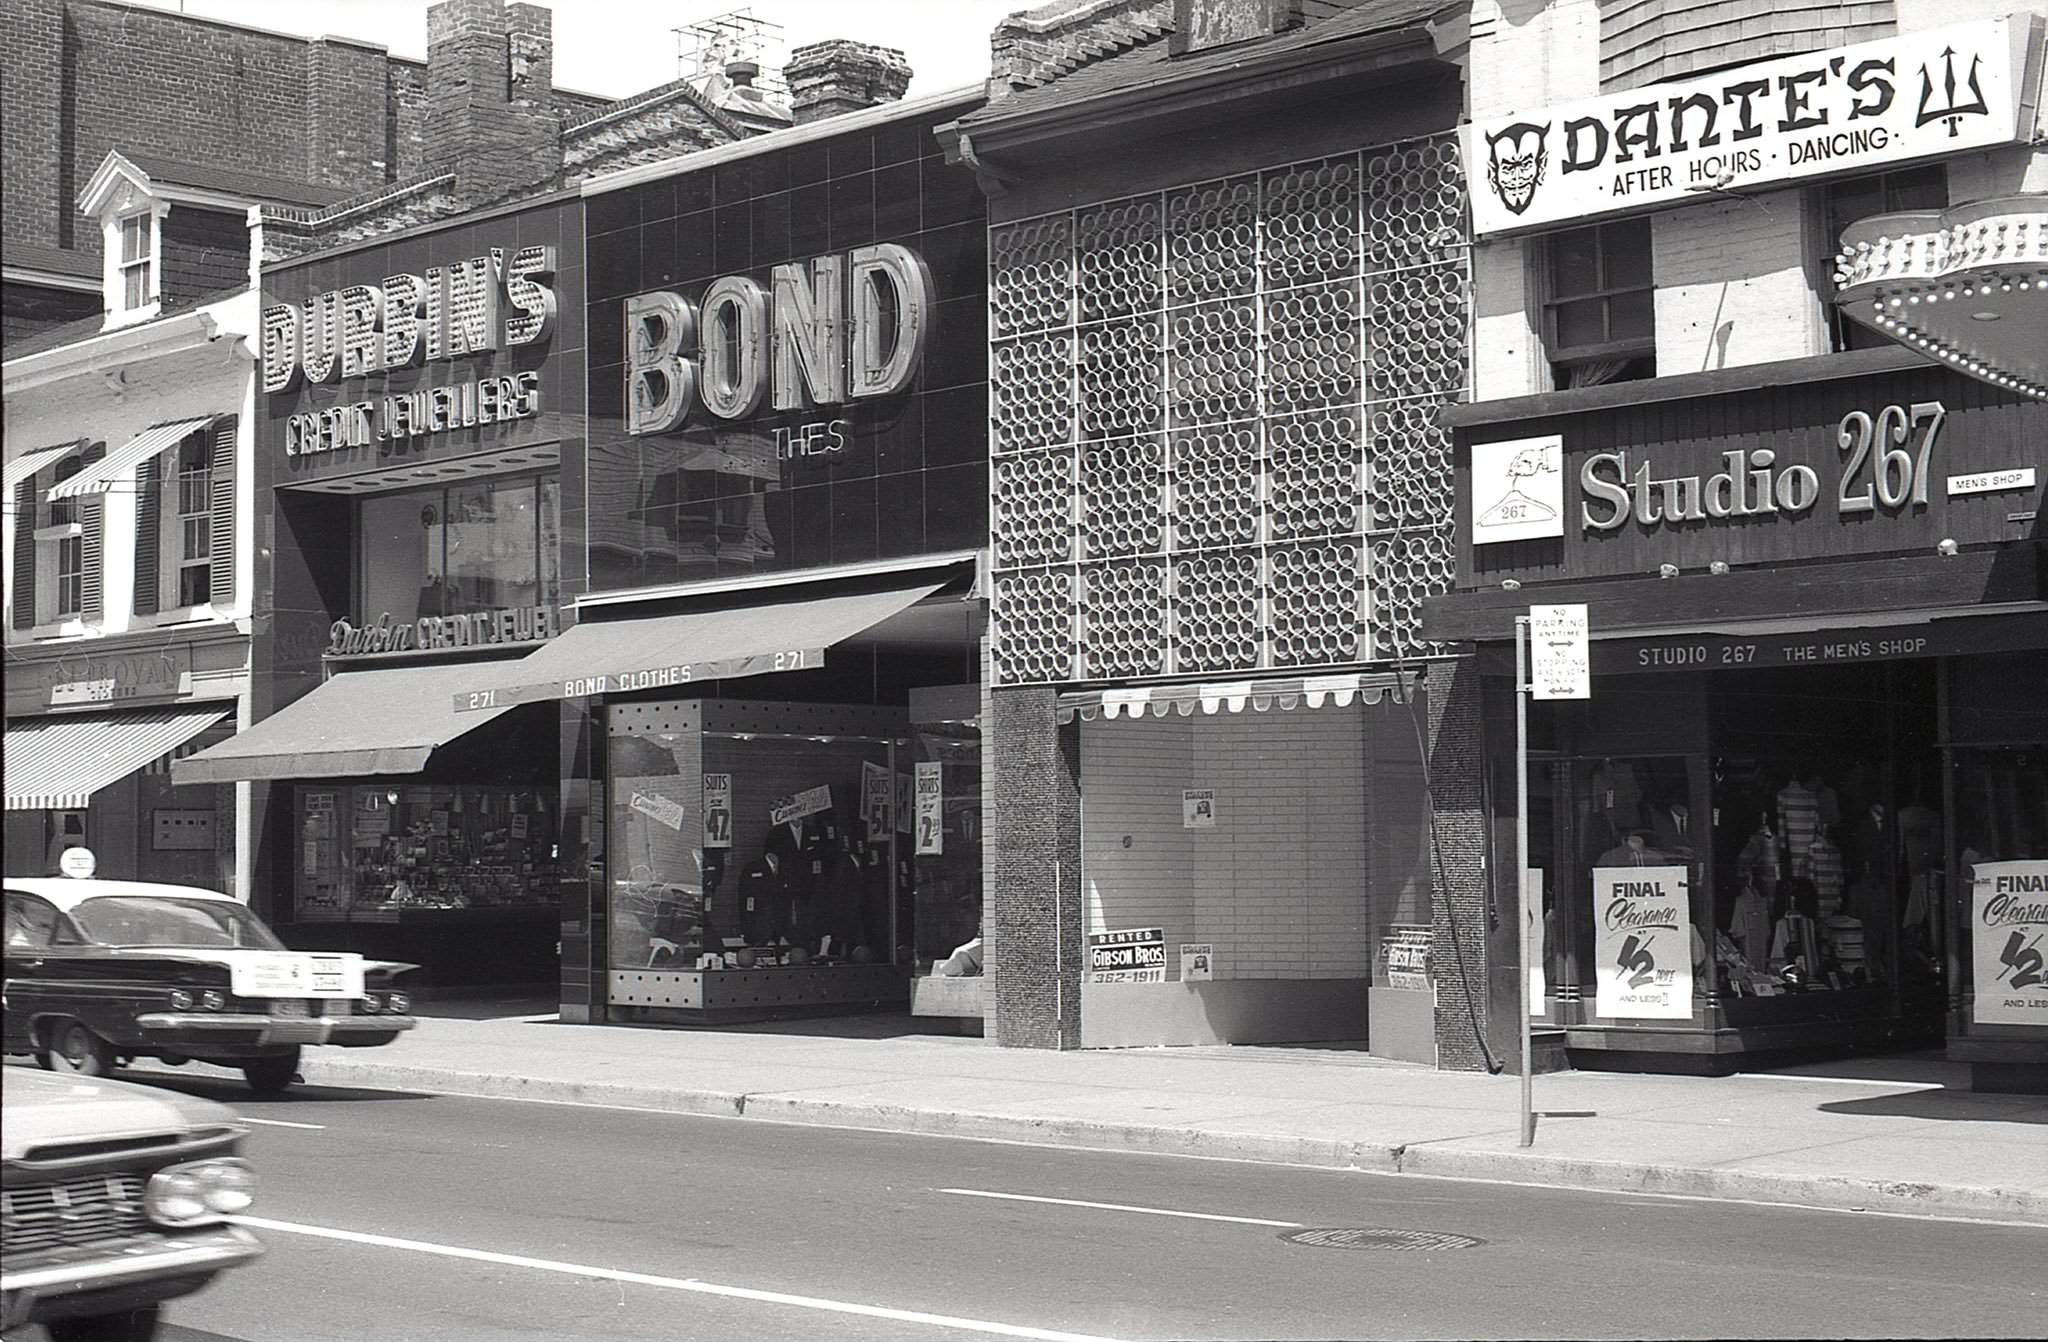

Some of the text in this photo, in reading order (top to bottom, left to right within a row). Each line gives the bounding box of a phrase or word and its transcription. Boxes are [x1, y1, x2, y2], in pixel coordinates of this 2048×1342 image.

[1562, 56, 1896, 175] DANTE'S
[1612, 128, 1889, 197] AFTER HOURS DANCING
[263, 246, 557, 393] DURBIN'S
[624, 243, 928, 436] BOND
[286, 371, 538, 456] CREDIT JEWELLERS
[772, 419, 845, 460] THES
[1581, 401, 1946, 531] Studio 267
[1992, 473, 2023, 486] SHOP
[1501, 504, 1528, 520] 267
[1535, 619, 1585, 628] PARKING
[1553, 608, 1567, 617] NO
[325, 611, 414, 656] Durbin
[417, 612, 488, 650] CREDIT
[1638, 638, 1927, 666] STUDIO 267 THE MEN'S SHOP
[470, 651, 805, 710] 271 BOND CLOTHES 271
[705, 775, 728, 791] SUITS
[1612, 882, 1666, 898] FINAL
[1605, 898, 1678, 931] Clearance
[1099, 931, 1152, 944] RENTED
[1093, 948, 1133, 967] GIBSON
[1094, 969, 1161, 983] 362-1911
[1619, 994, 1638, 1003] AND
[2003, 999, 2025, 1008] AND
